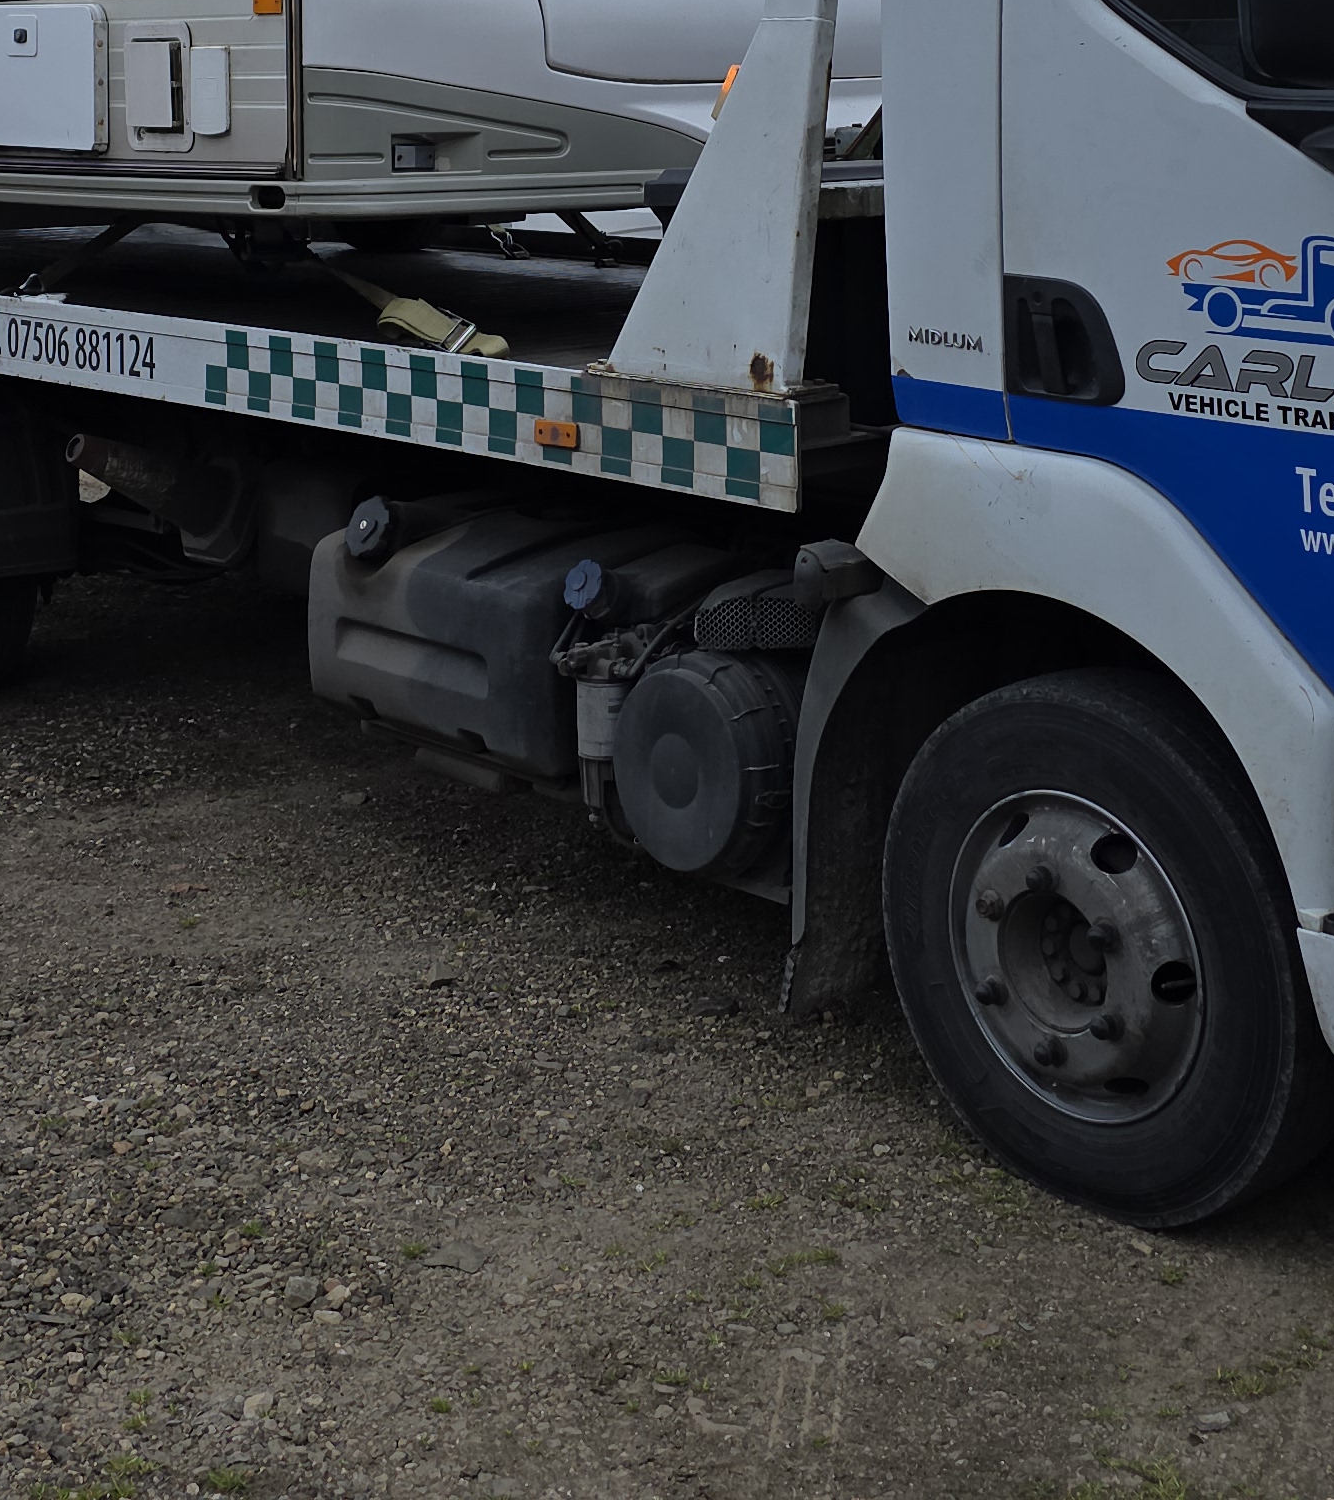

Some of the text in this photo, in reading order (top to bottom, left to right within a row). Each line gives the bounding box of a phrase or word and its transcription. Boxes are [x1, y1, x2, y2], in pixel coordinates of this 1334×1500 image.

[8, 318, 69, 366] 07506
[75, 328, 155, 379] 881124
[908, 326, 983, 353] MIDLUM
[1168, 392, 1269, 422] VEHICLE
